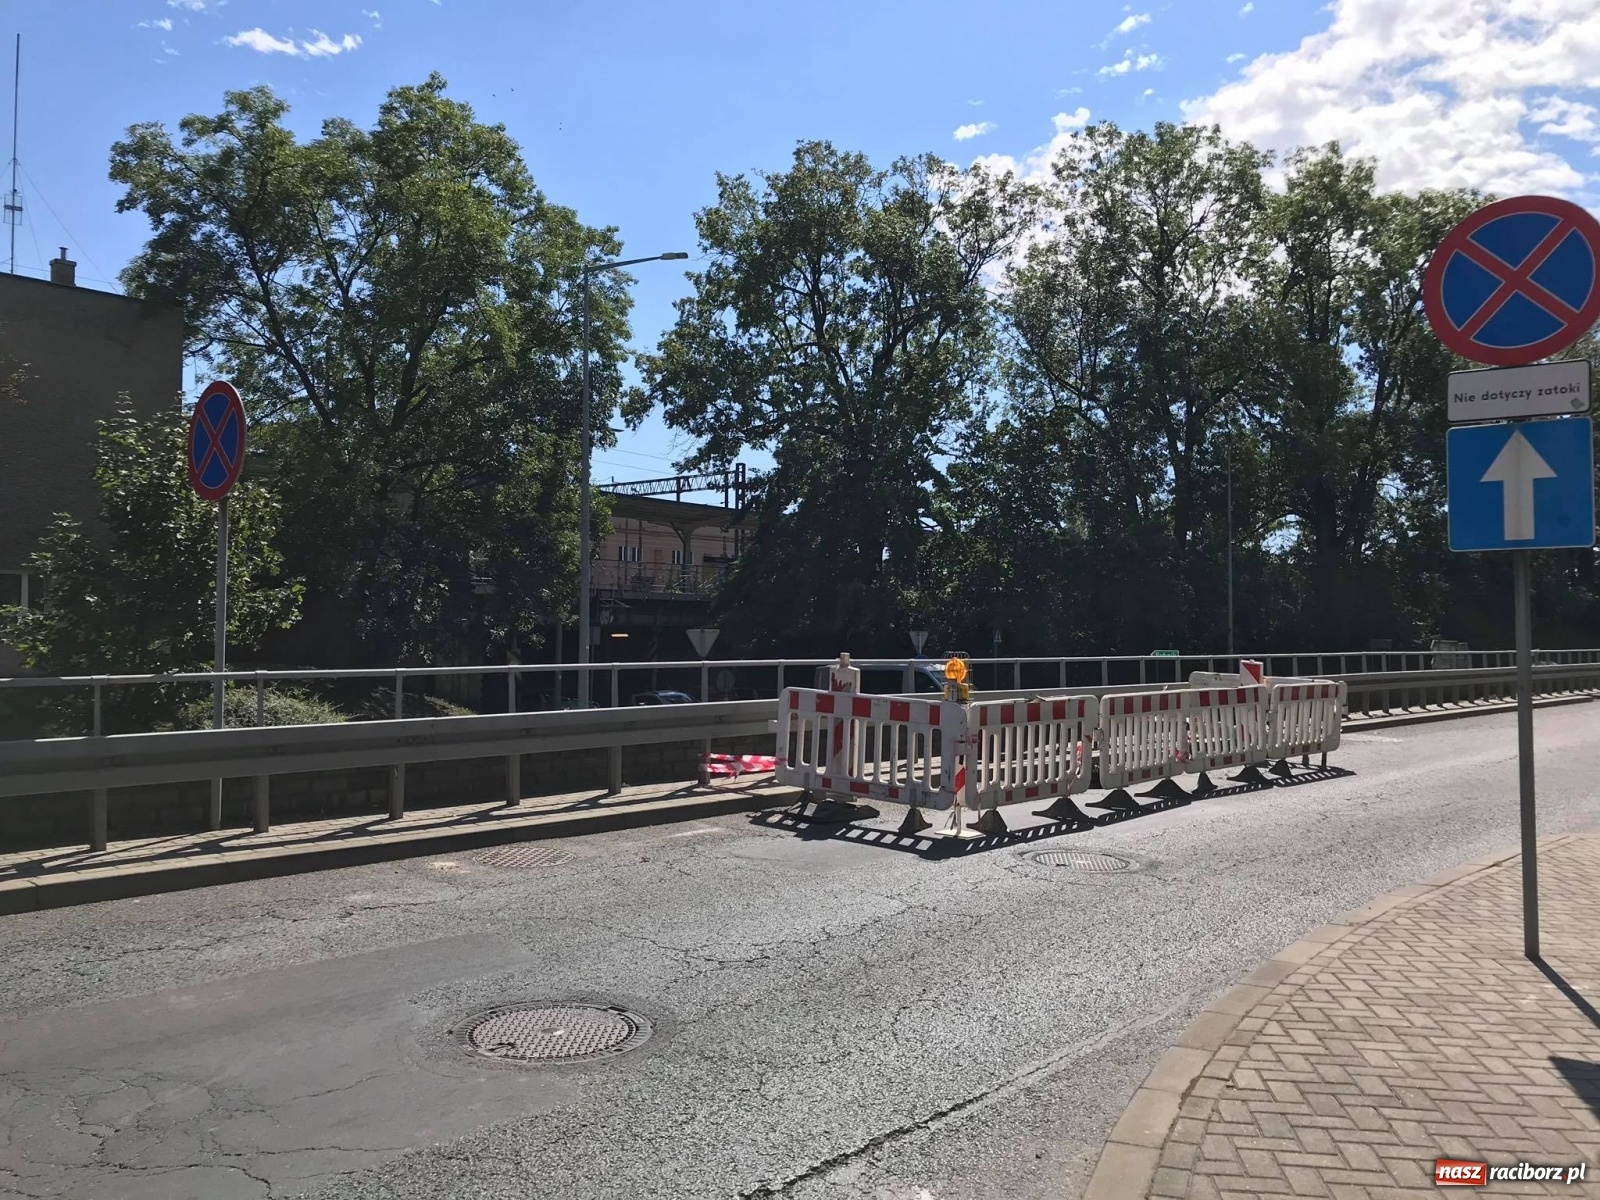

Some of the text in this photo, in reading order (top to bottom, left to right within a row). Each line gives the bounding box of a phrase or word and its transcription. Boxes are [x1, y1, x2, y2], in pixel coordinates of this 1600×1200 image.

[1454, 382, 1581, 403] Nie dotyczy zatoki
